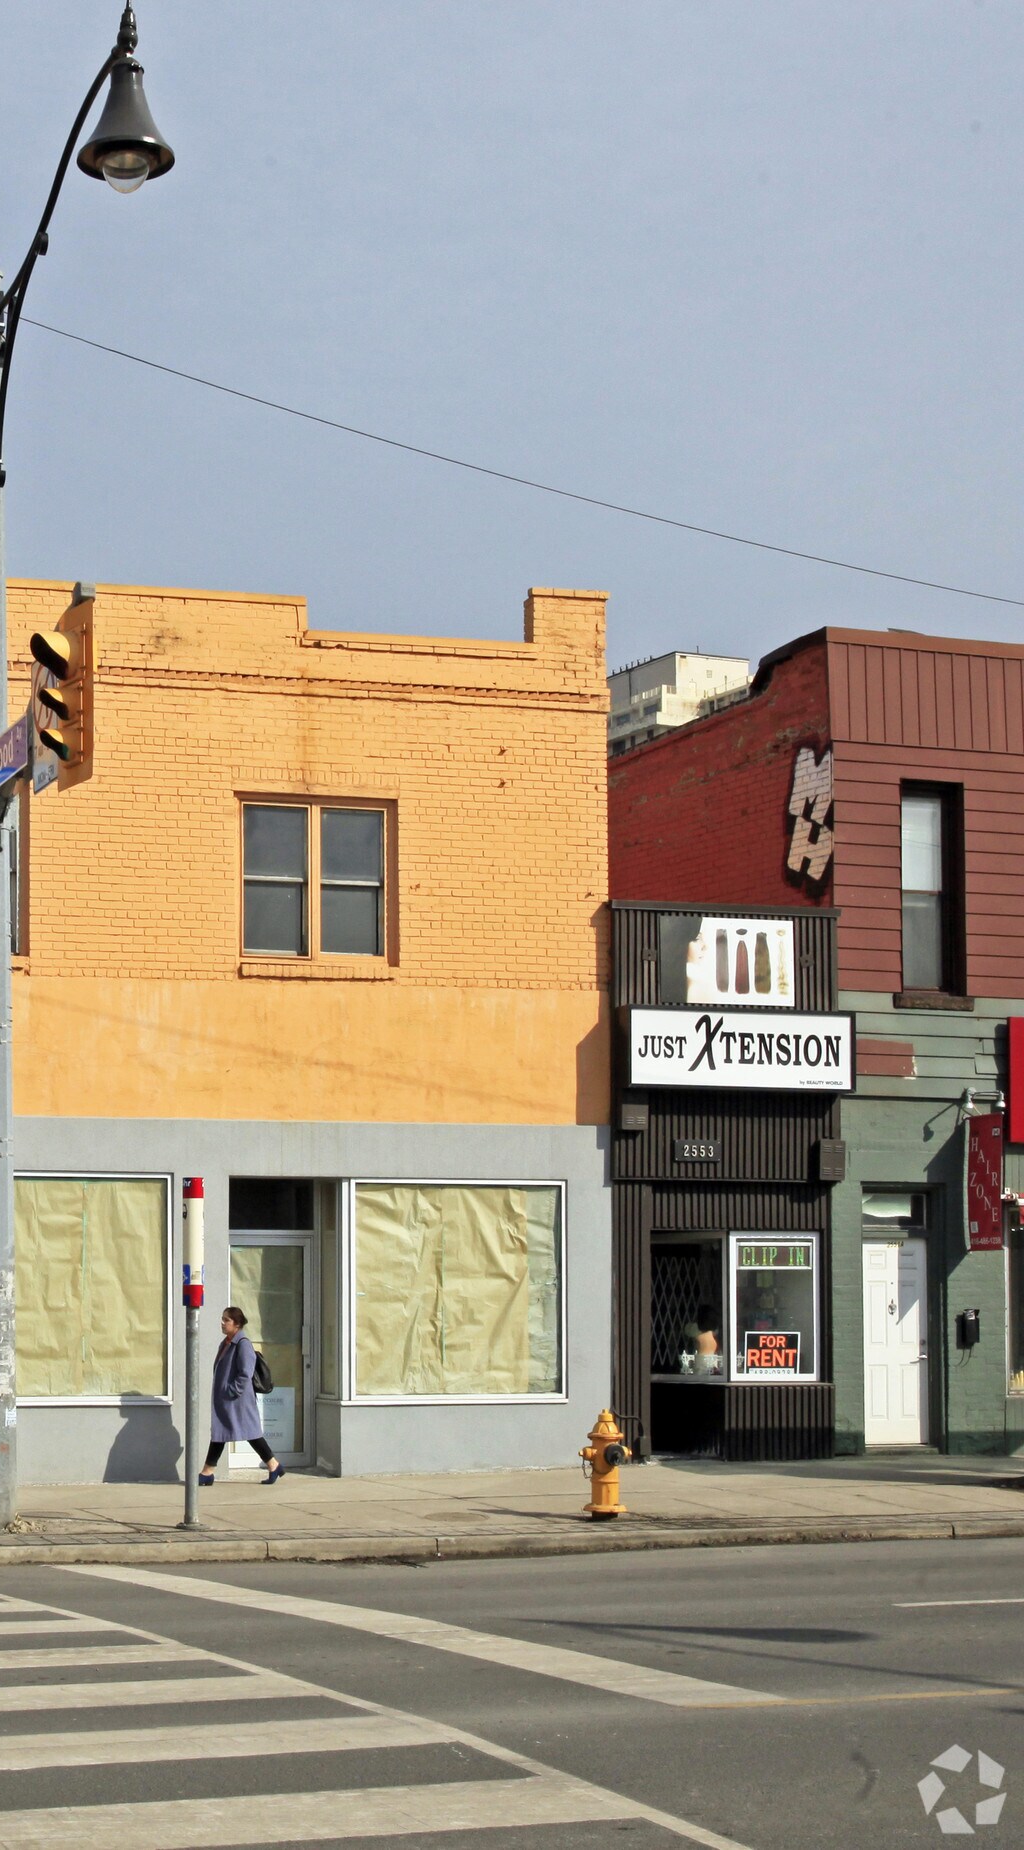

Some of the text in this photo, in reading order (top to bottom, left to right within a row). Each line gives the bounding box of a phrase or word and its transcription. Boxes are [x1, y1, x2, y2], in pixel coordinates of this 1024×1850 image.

[638, 1014, 841, 1072] JUST XTENSION
[683, 1144, 714, 1157] 2553
[742, 1247, 805, 1266] CLIP IN
[759, 1335, 786, 1348] FOR
[747, 1349, 797, 1367] RENT
